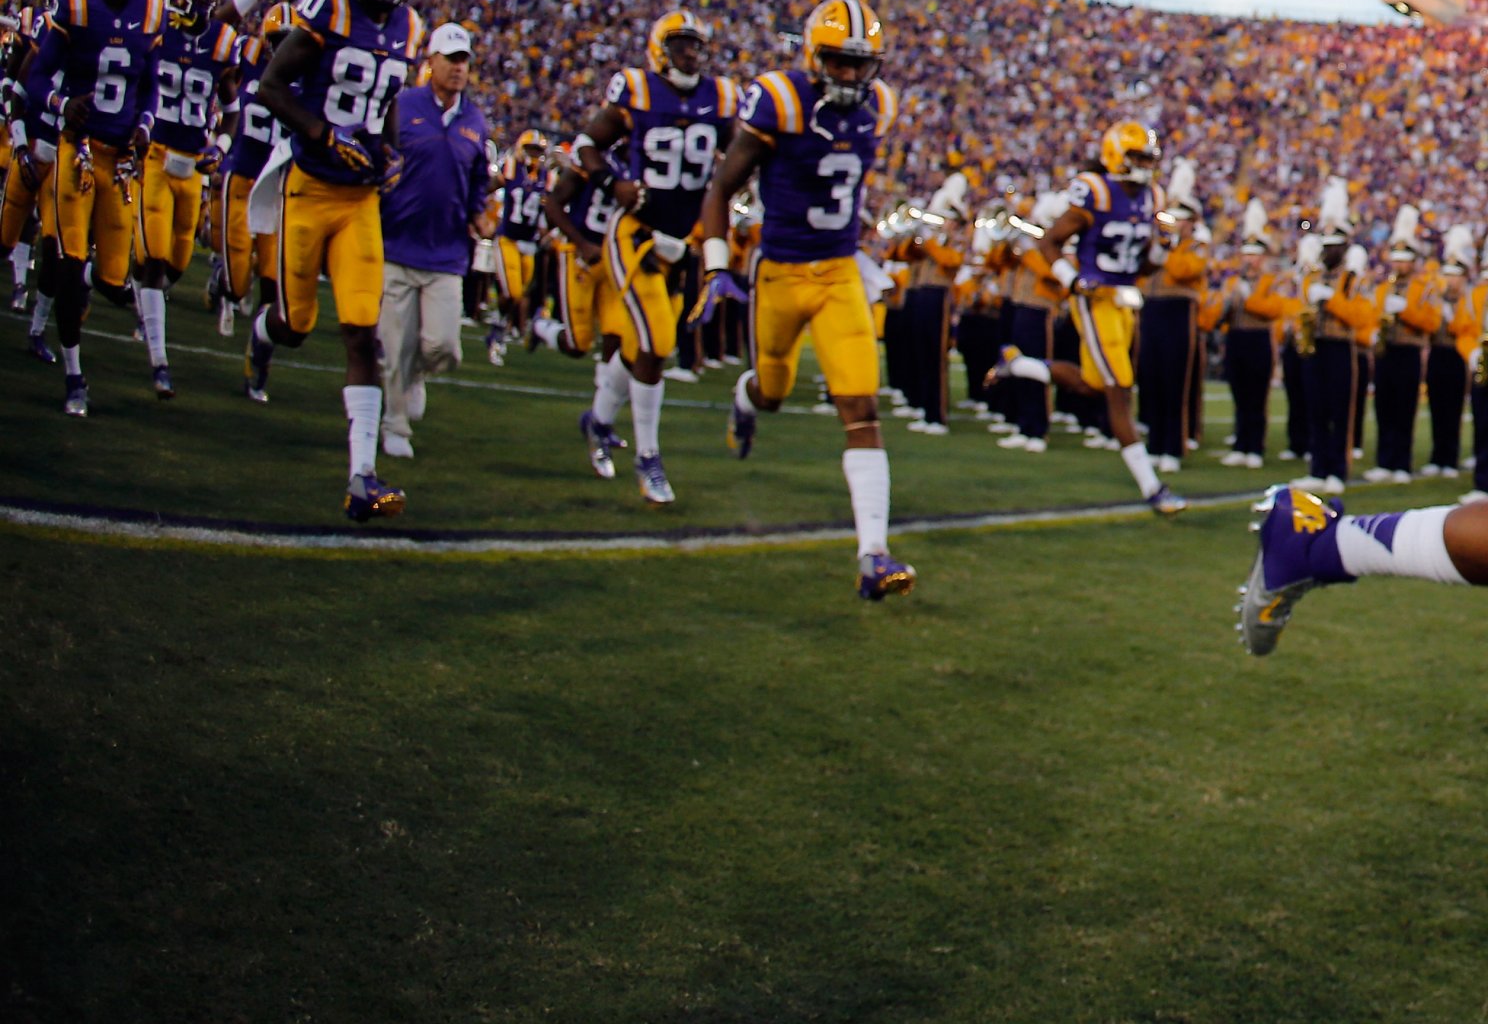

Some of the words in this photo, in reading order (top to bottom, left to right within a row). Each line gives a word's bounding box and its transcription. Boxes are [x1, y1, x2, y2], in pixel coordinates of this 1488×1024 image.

[94, 46, 131, 114] 6
[155, 59, 213, 128] 28
[323, 46, 408, 135] 80
[738, 83, 763, 121] 3
[643, 123, 718, 191] 99
[508, 187, 541, 224] 14
[807, 153, 863, 231] 3
